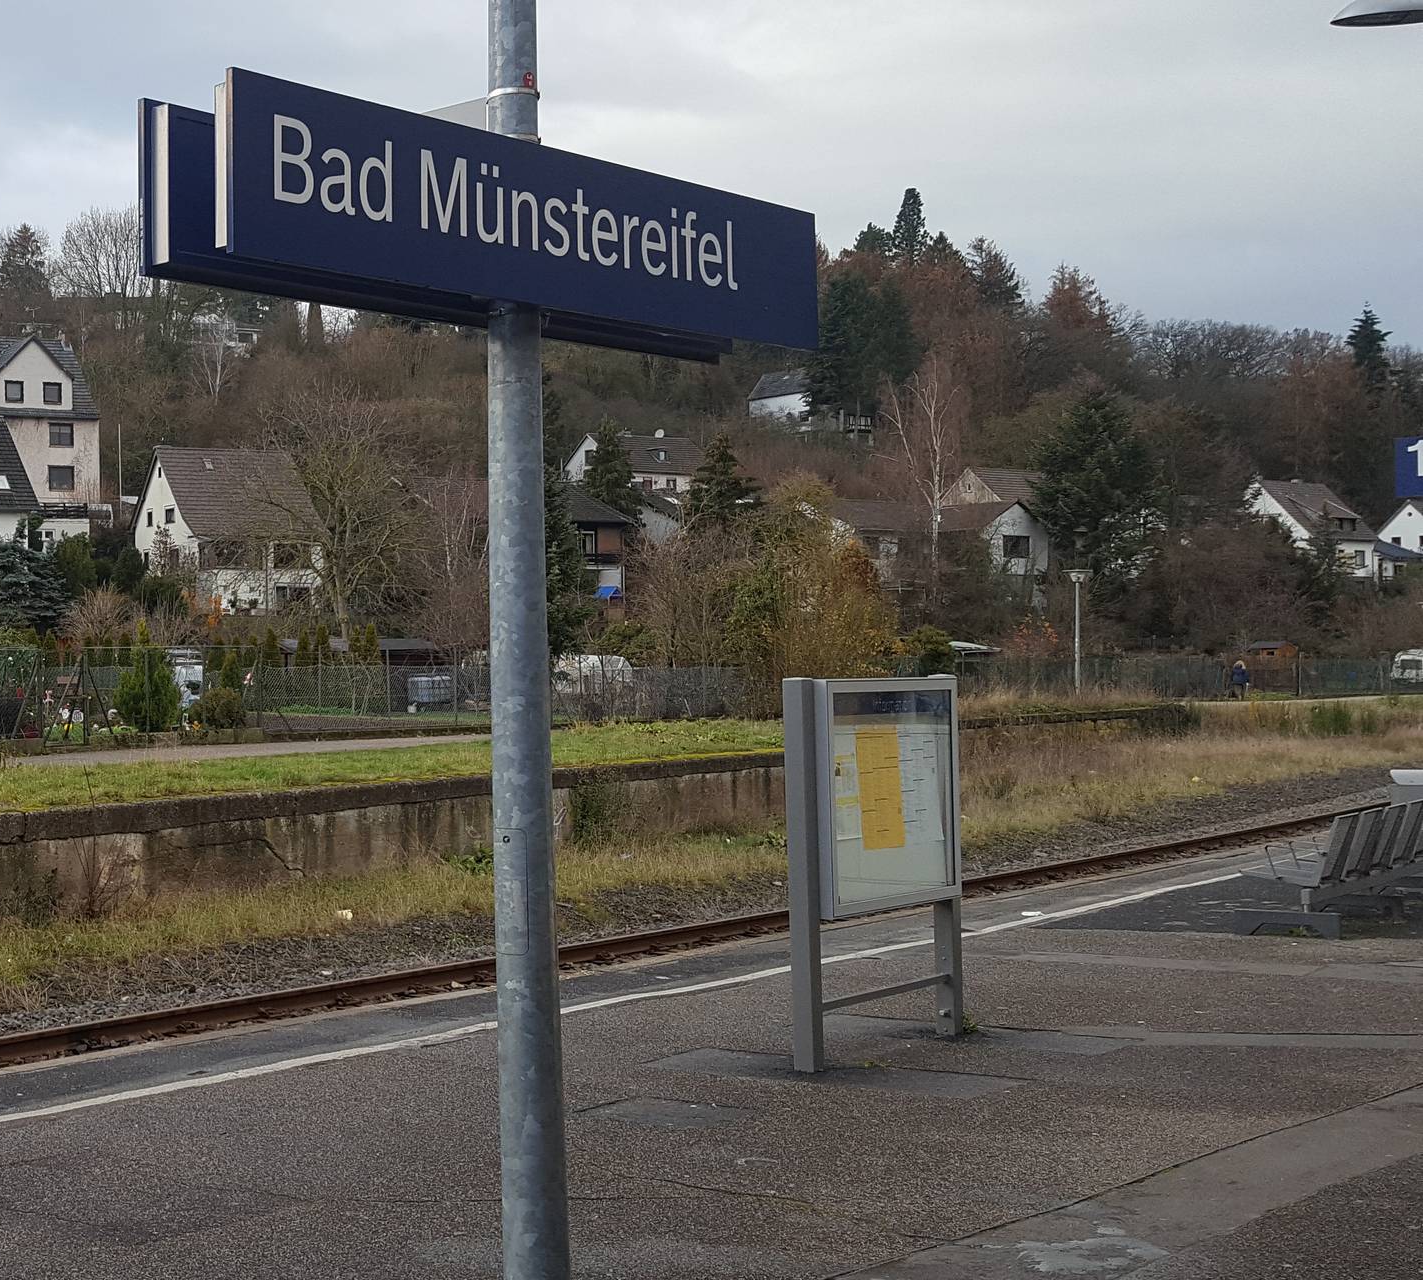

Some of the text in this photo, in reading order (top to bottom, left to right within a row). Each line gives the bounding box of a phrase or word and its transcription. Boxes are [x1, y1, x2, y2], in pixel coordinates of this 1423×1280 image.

[273, 114, 738, 291] Bad Münstereifel
[1407, 439, 1423, 477] 1
